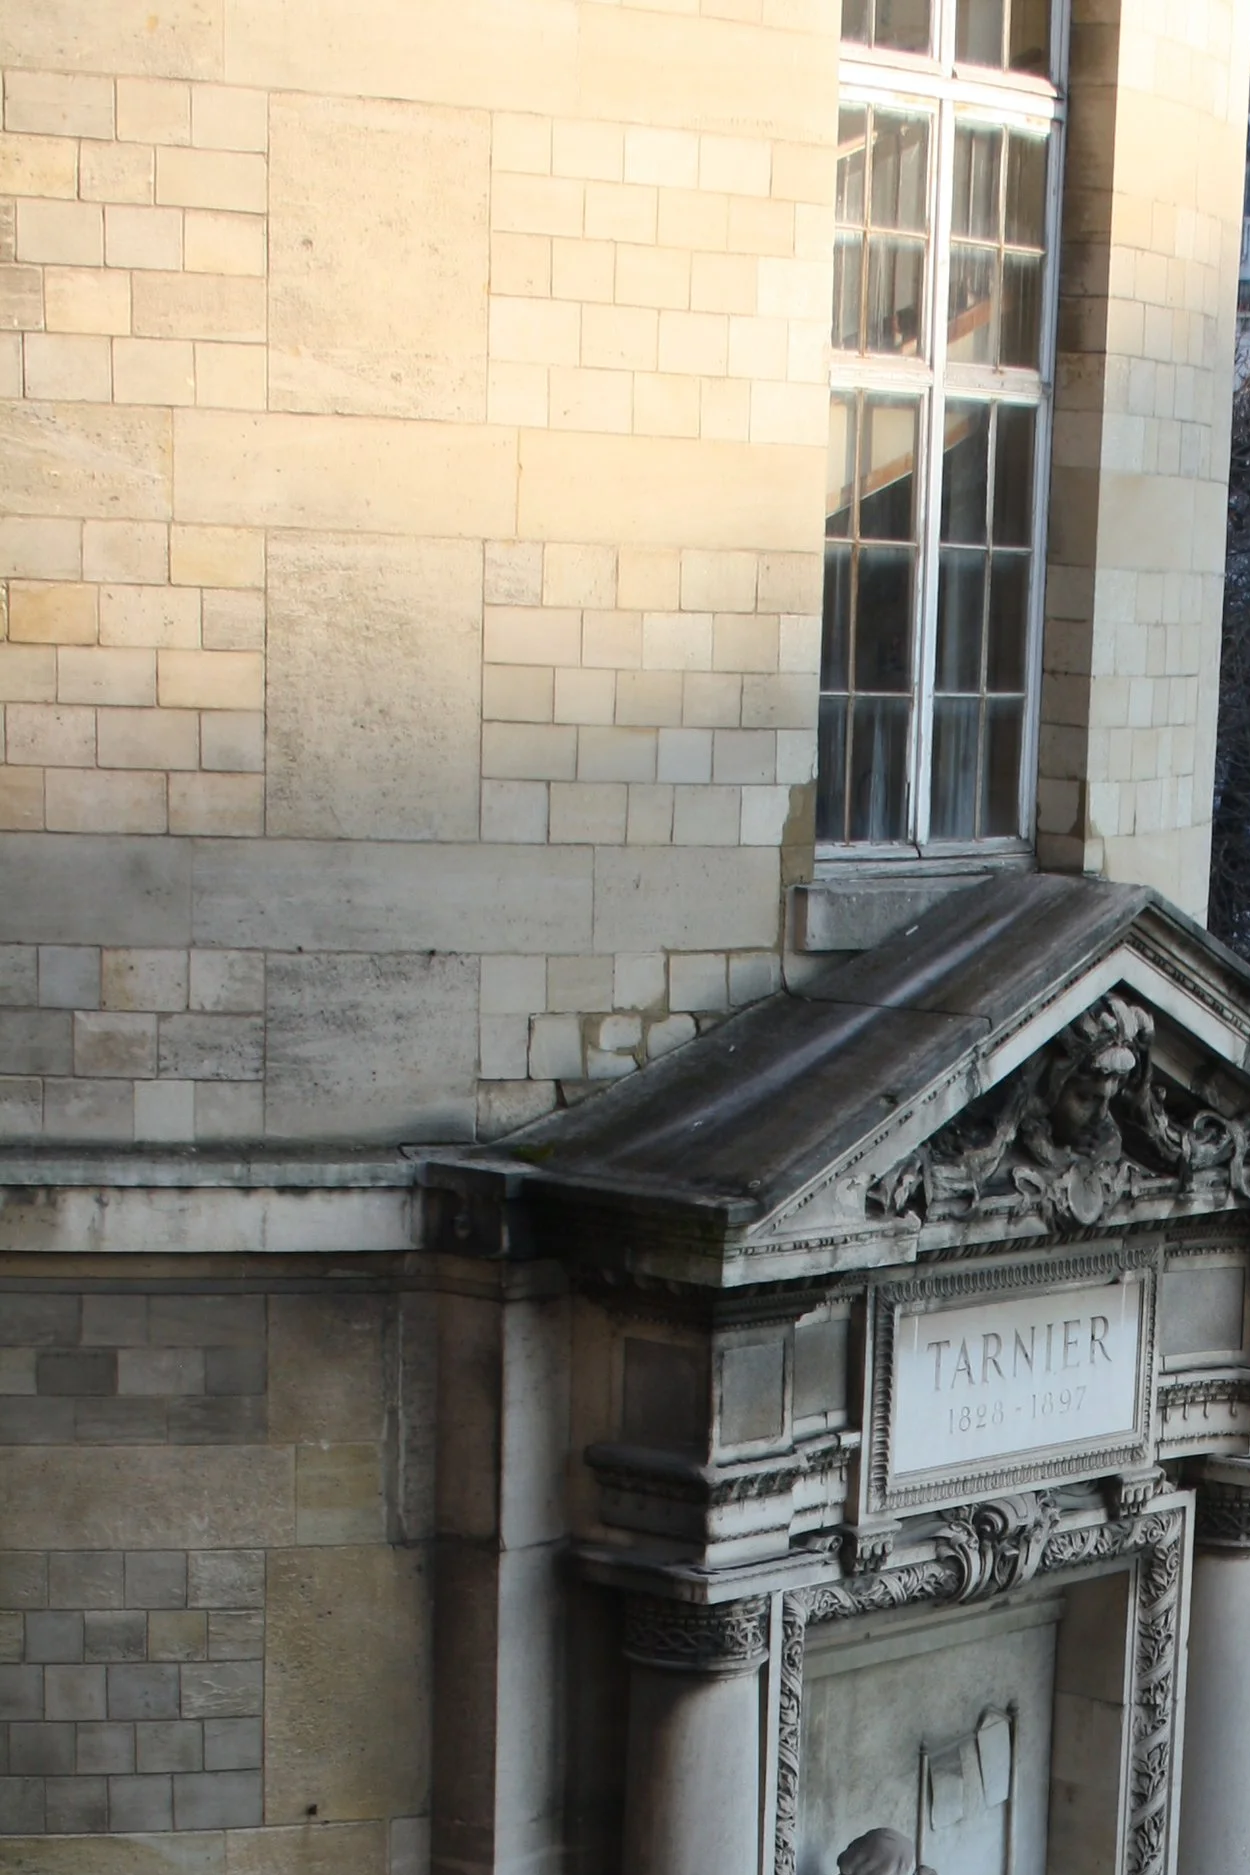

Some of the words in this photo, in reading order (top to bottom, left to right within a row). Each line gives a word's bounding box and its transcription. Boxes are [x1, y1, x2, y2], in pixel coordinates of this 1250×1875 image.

[927, 1315, 1112, 1391] TARNIER
[948, 1401, 1004, 1435] 1828
[1031, 1385, 1086, 1419] 1897
